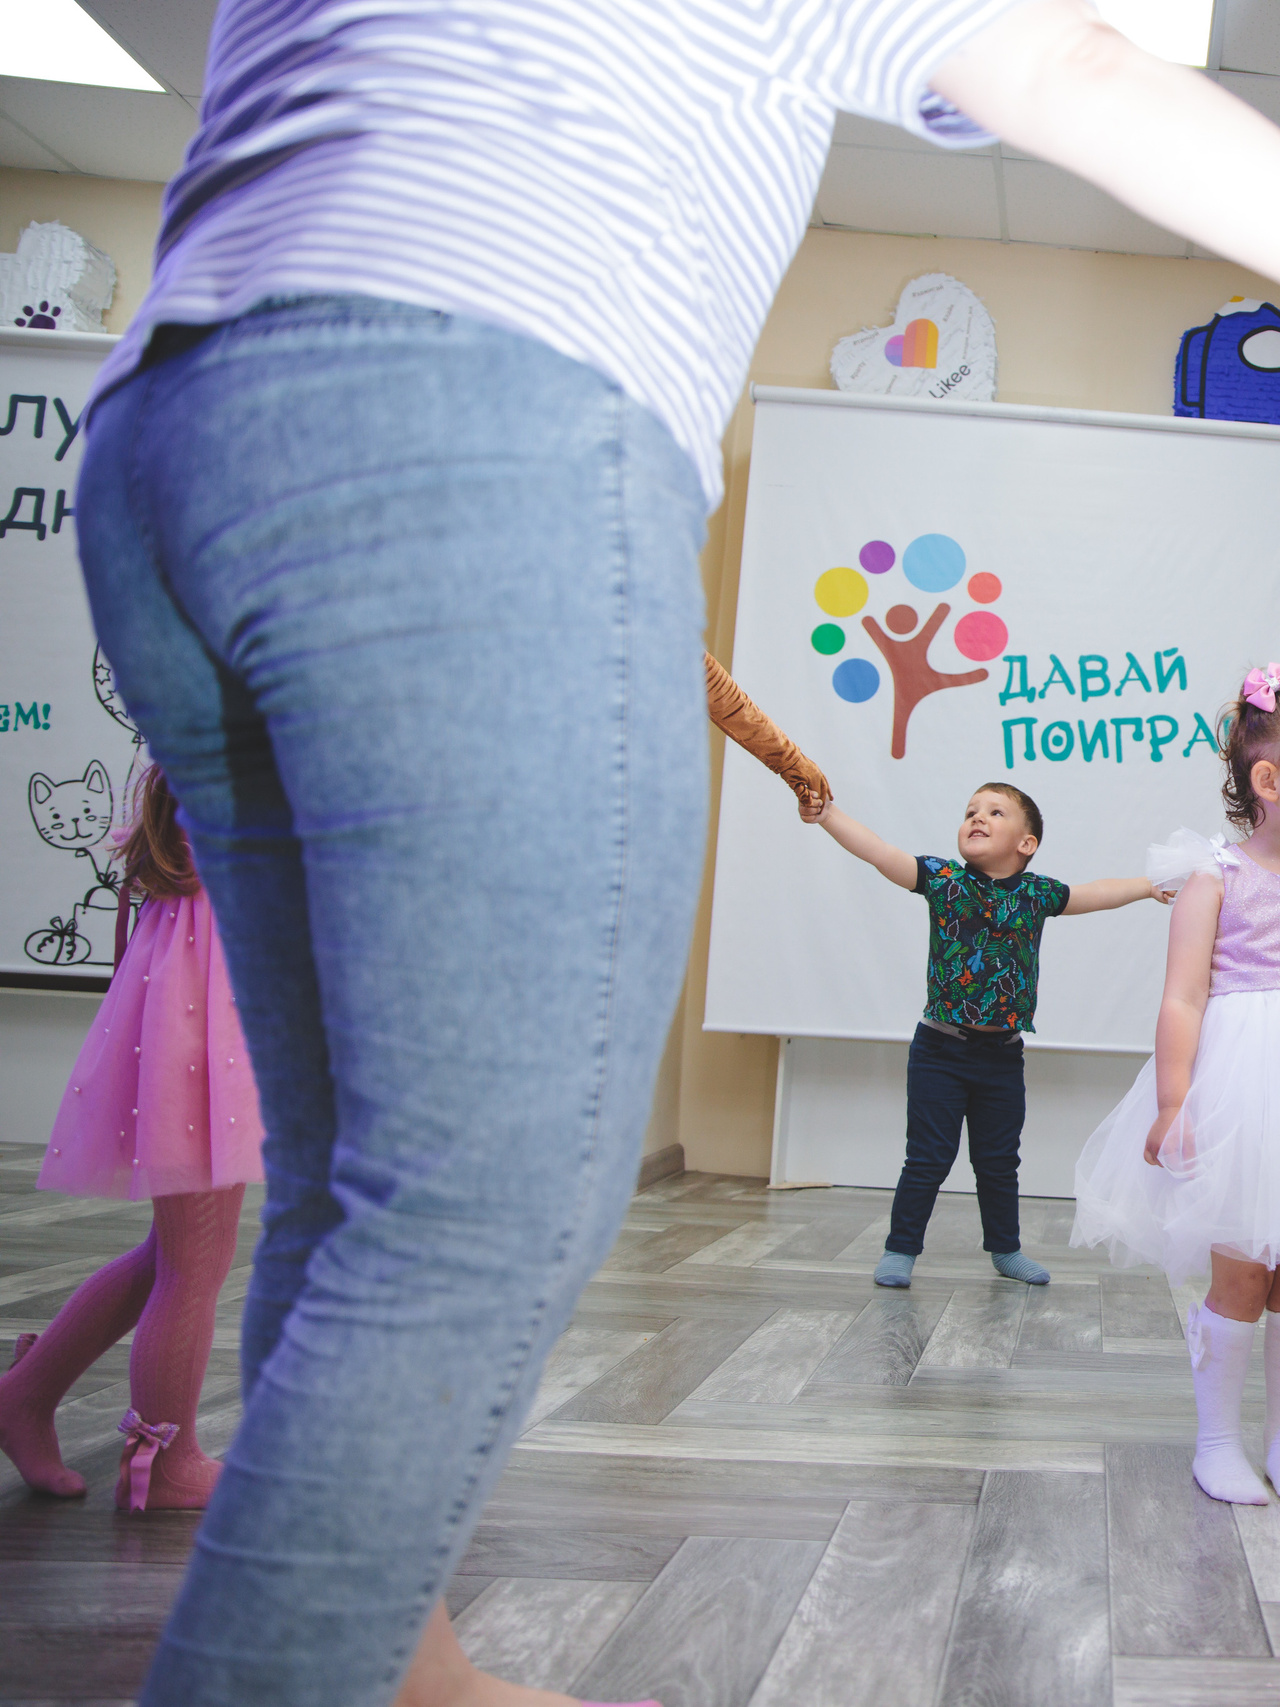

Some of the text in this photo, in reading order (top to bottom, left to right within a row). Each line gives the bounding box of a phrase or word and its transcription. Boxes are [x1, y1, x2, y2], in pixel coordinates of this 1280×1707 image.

[929, 365, 971, 399] Likee
[999, 647, 1187, 706] ДАВАЙ
[1001, 711, 1234, 769] ПОИГРА
